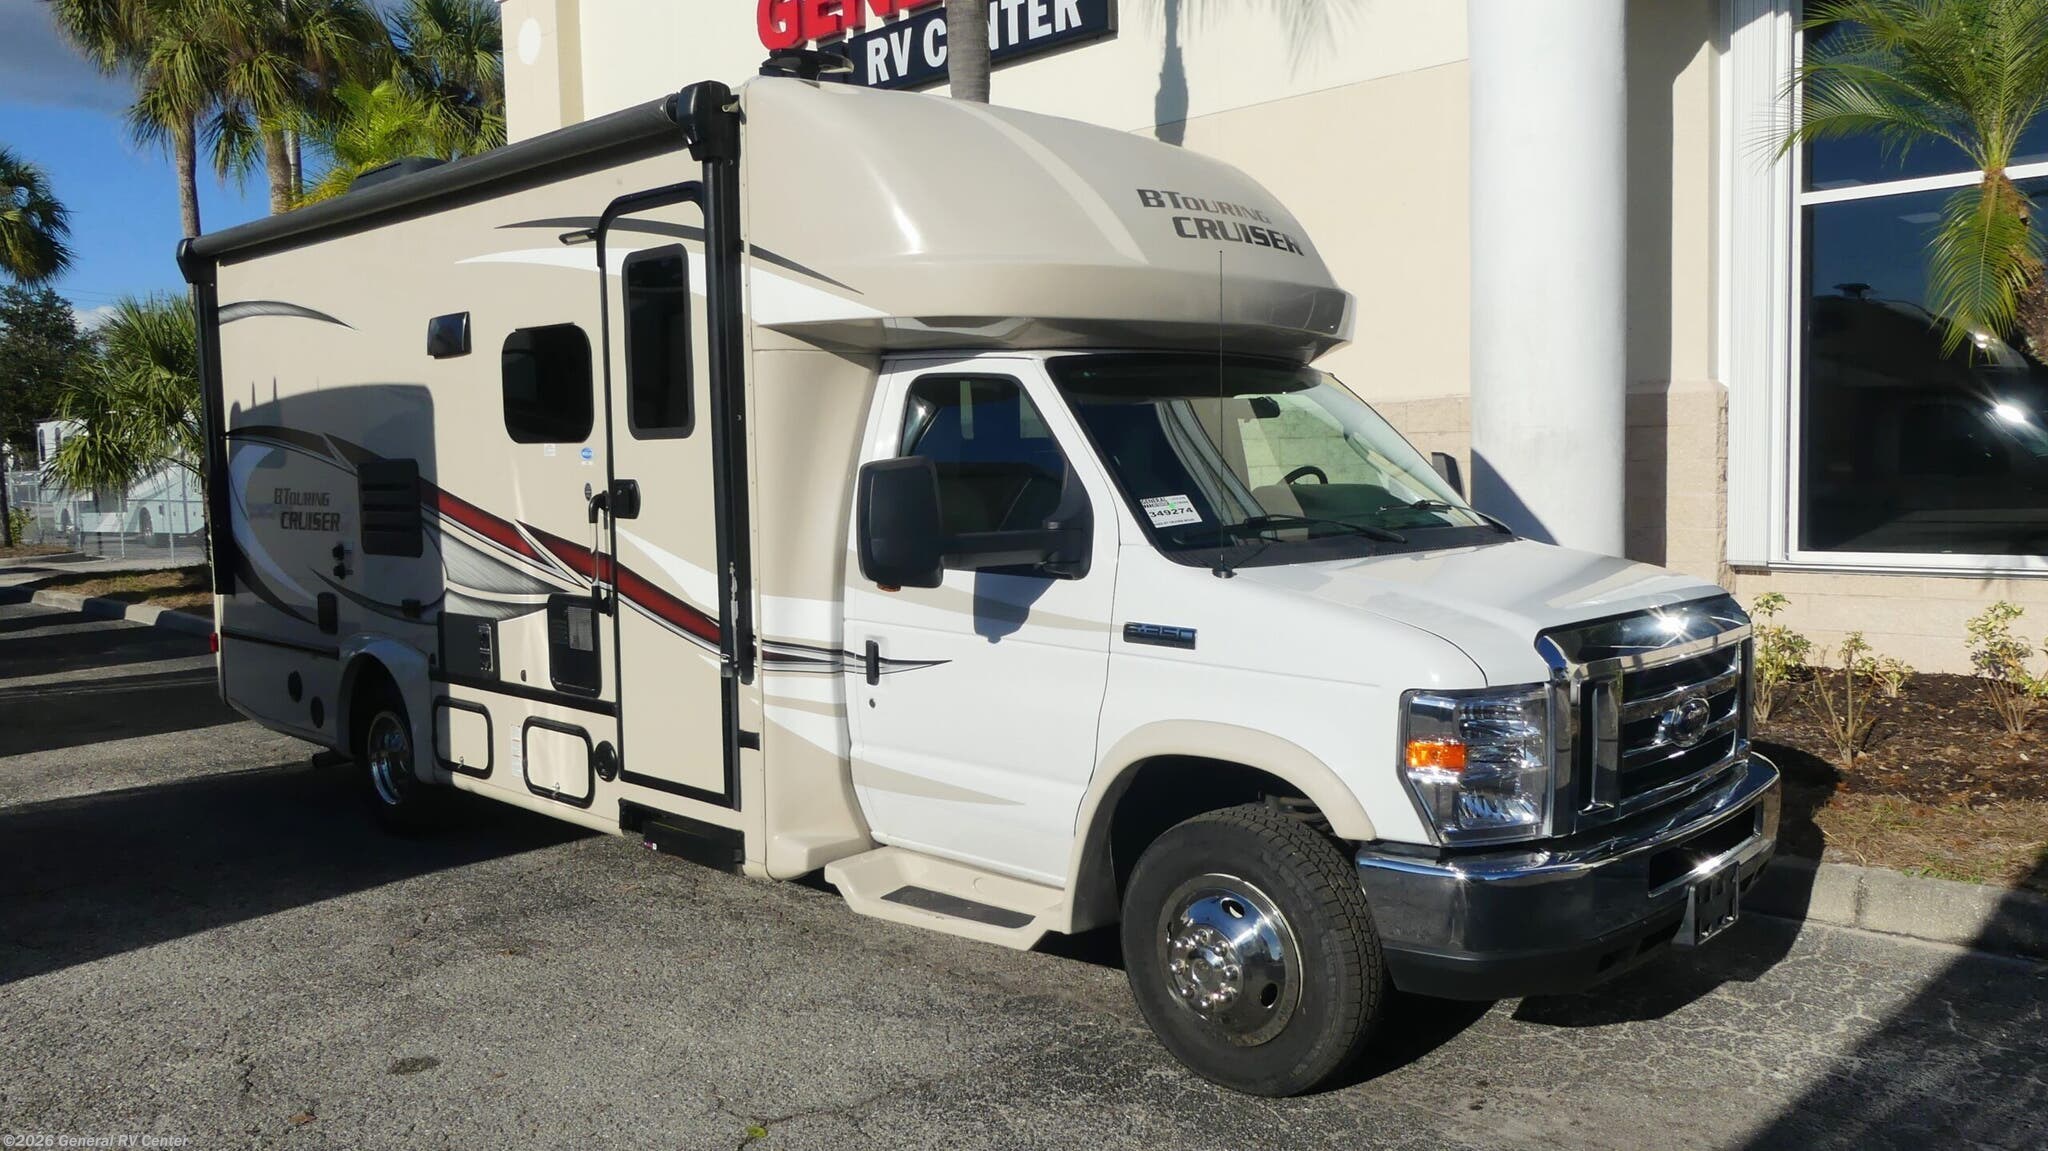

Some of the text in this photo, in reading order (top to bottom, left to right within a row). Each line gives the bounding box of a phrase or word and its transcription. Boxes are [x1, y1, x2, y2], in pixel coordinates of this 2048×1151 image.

[866, 0, 1083, 86] RV CTER
[1172, 216, 1305, 257] CRUISER
[281, 511, 340, 532] CRUISER
[1149, 507, 1193, 518] 349274
